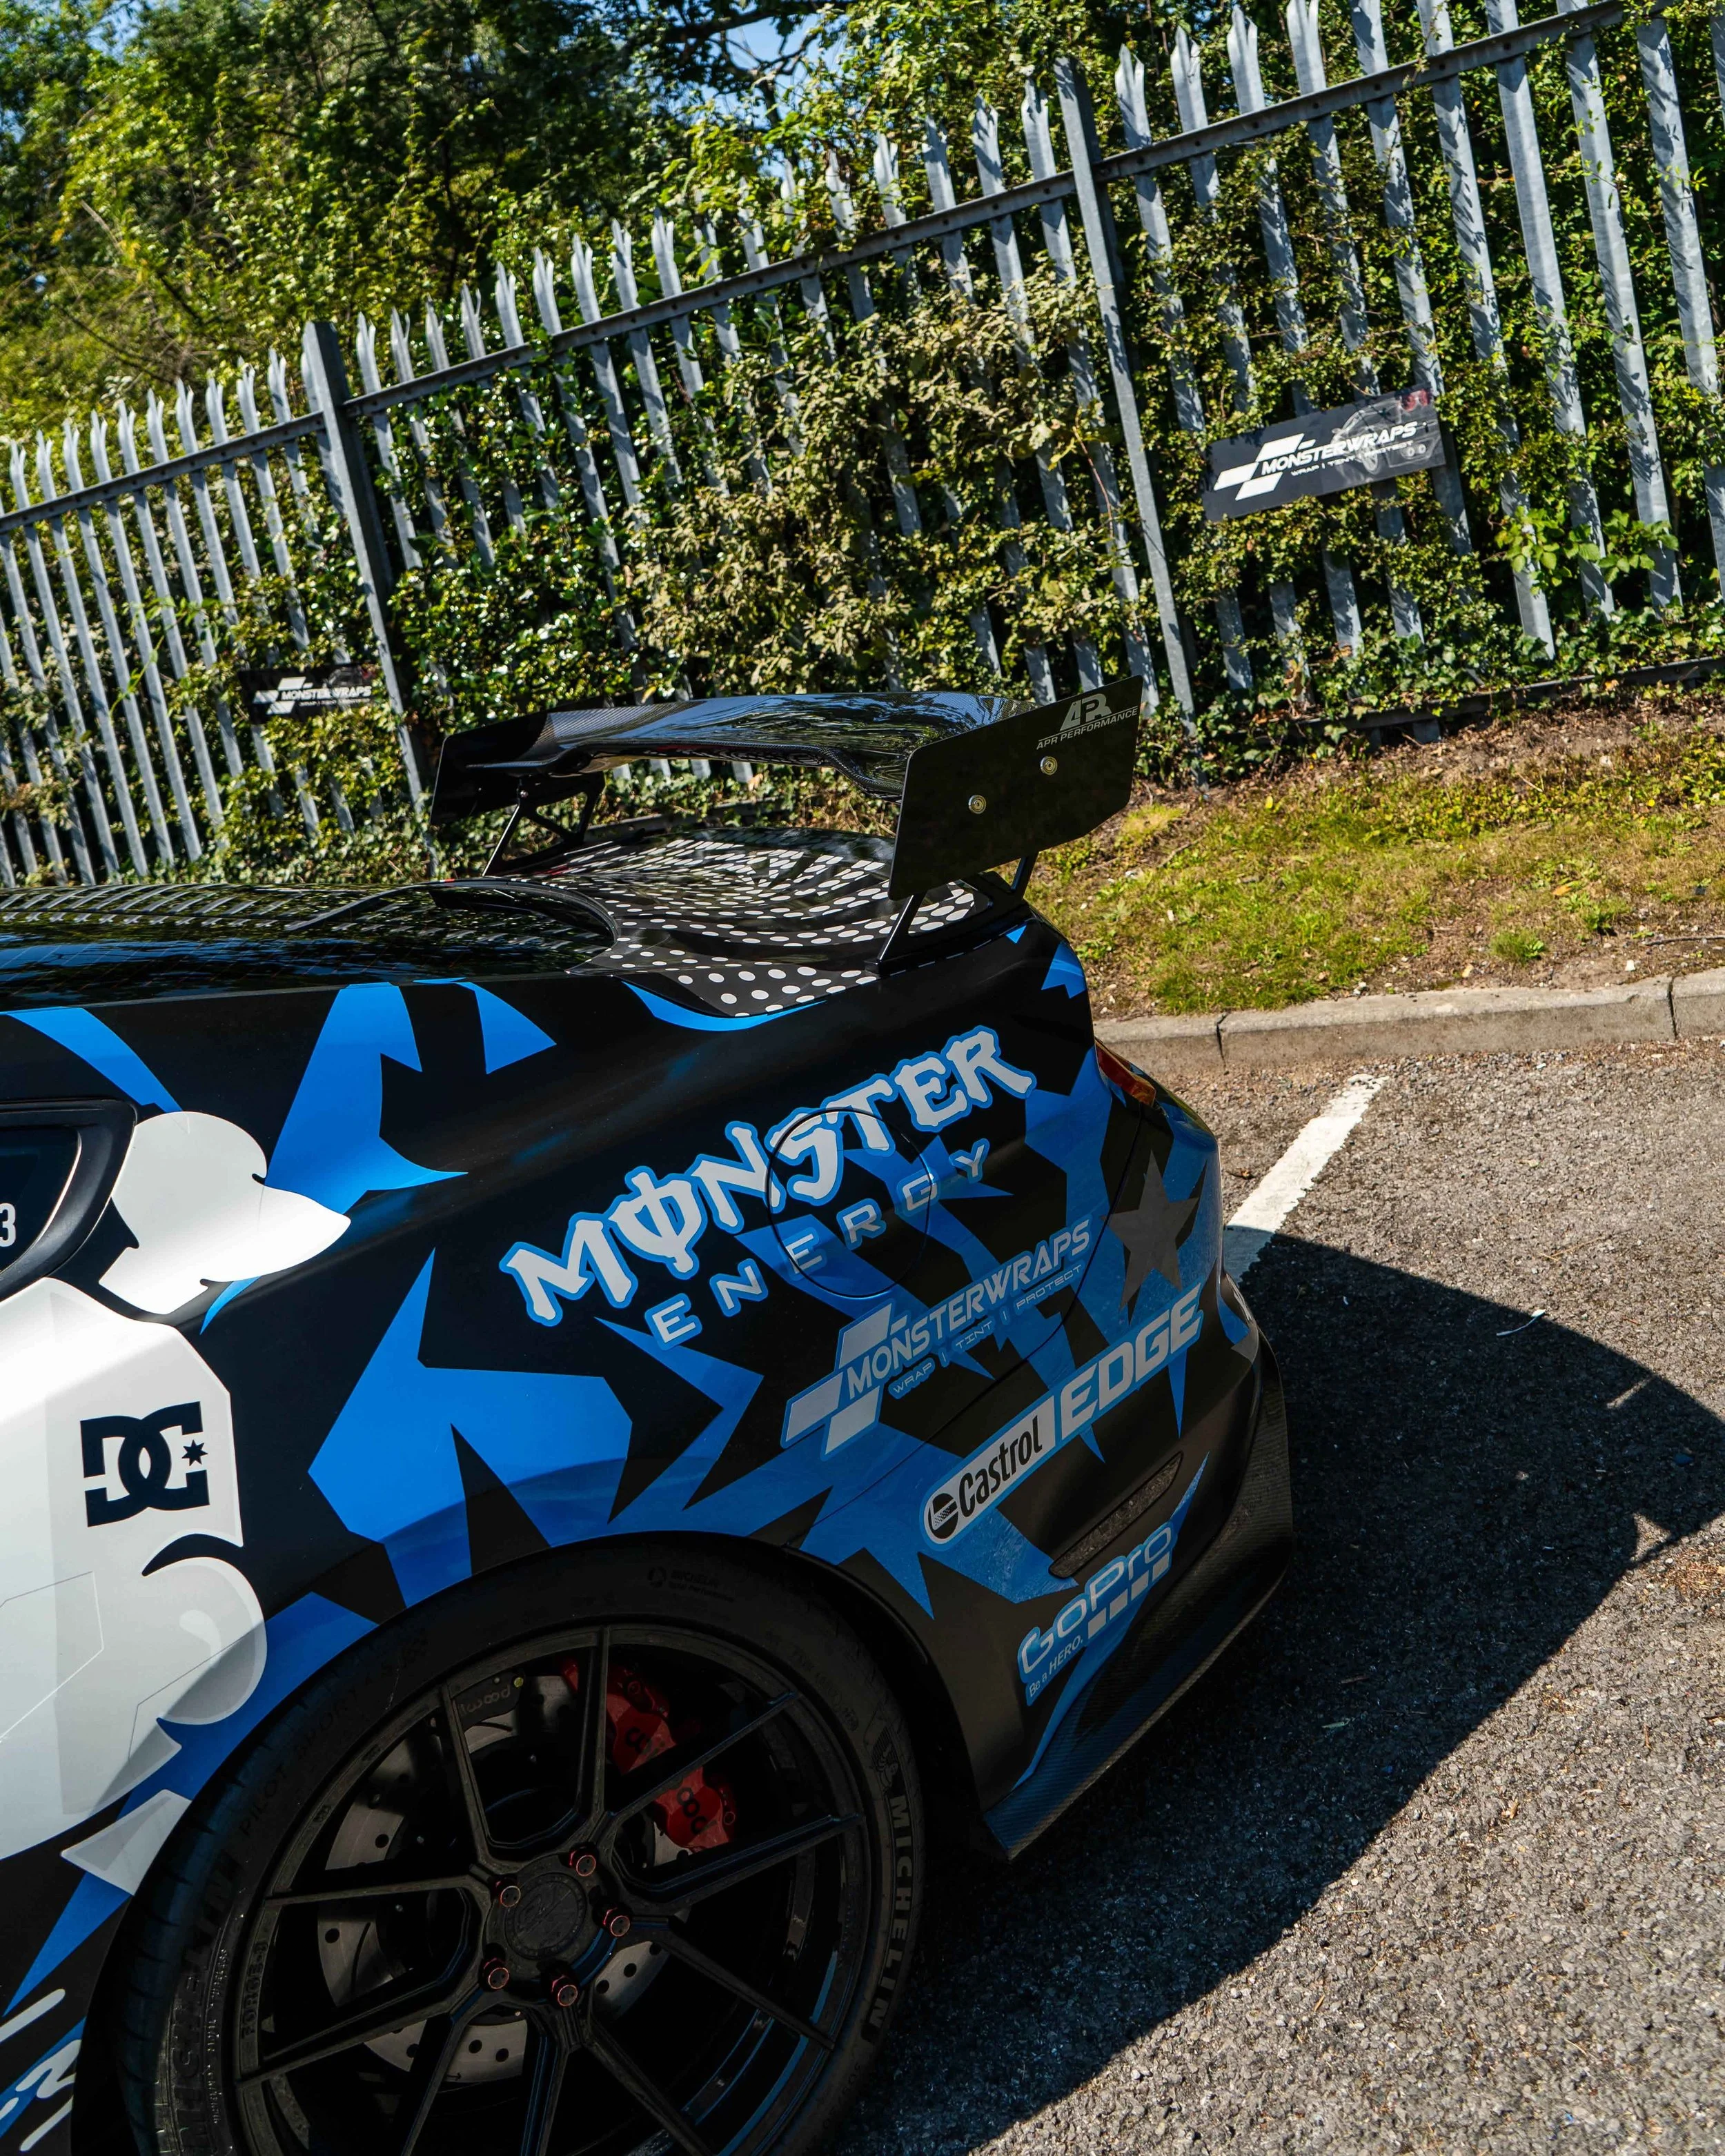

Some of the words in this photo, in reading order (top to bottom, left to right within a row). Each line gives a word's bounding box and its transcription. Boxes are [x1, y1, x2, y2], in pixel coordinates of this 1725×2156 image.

[1261, 422, 1417, 476] MONSTERWRAPS
[1036, 737, 1058, 751] APR
[1060, 708, 1138, 742] PERFORMANCE
[502, 1027, 1035, 1322] MONSTER
[651, 1143, 986, 1344] ENERGY
[845, 1218, 1090, 1400] MONSTERWRAPS
[894, 1362, 931, 1394] WRAP
[956, 1322, 993, 1349] TINT
[1016, 1265, 1082, 1309] PROTECT
[959, 1415, 1043, 1518] Castrol
[1061, 1283, 1201, 1438] EDGE
[1021, 1527, 1172, 1674] GoPro
[868, 1794, 914, 2027] MICHELIN
